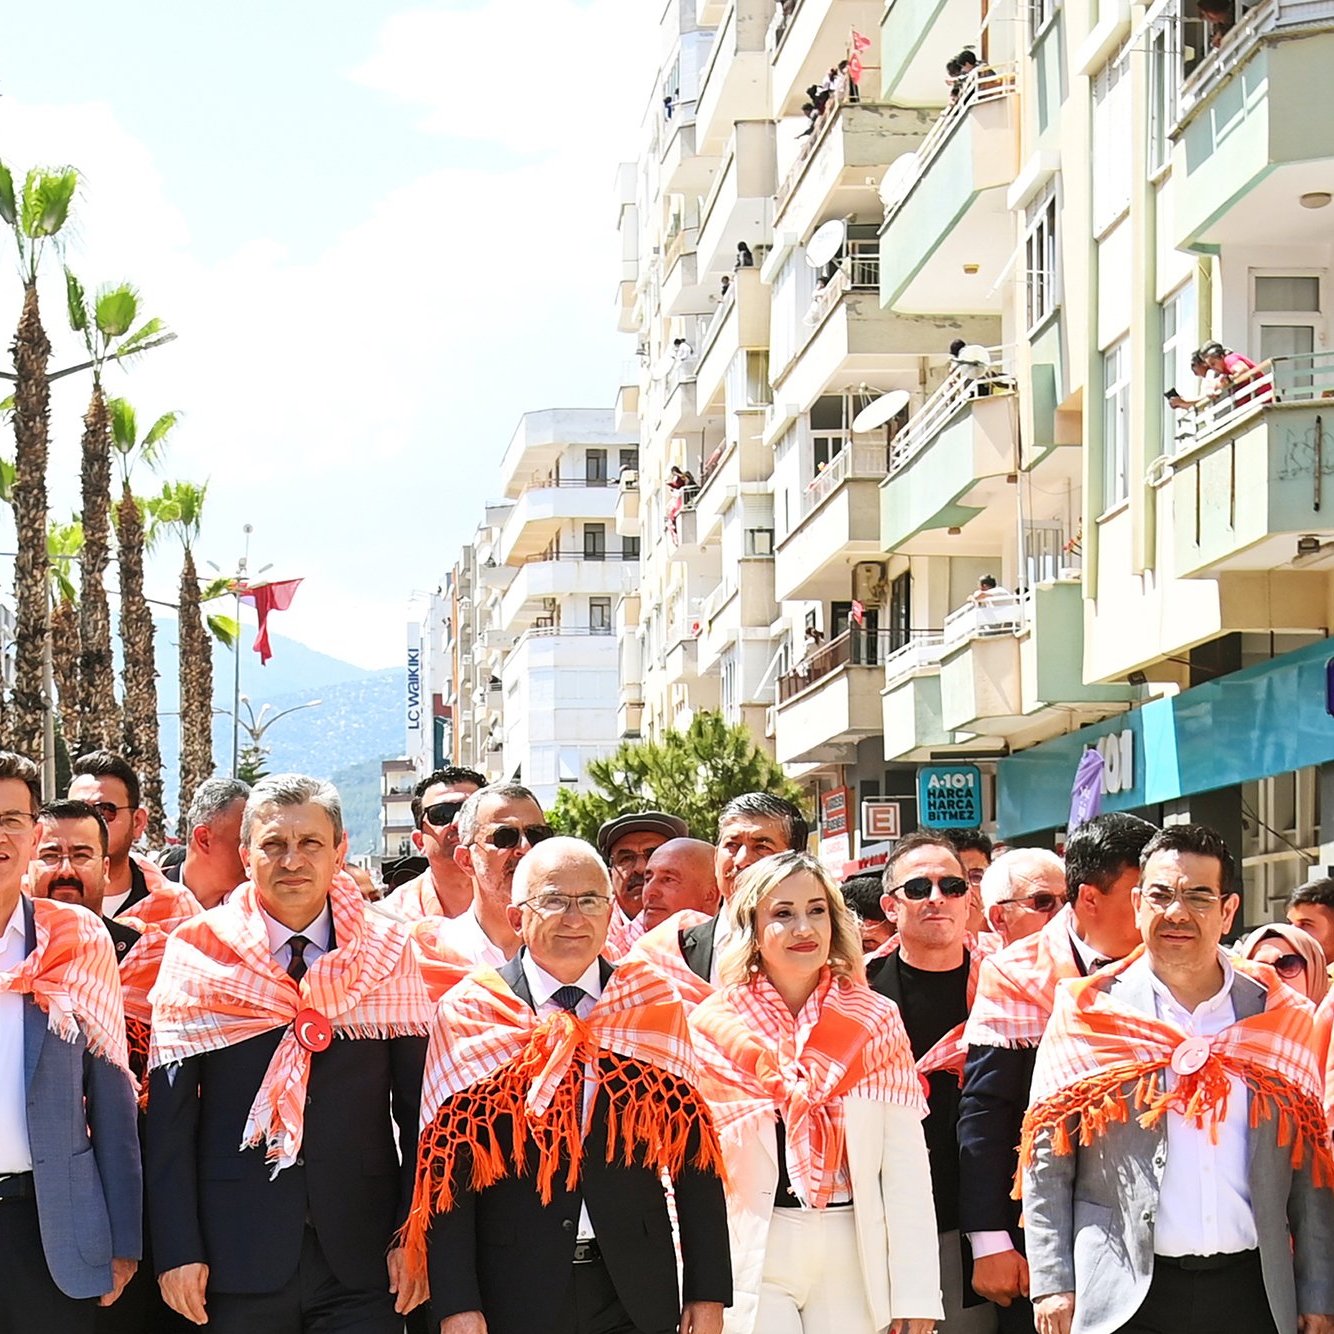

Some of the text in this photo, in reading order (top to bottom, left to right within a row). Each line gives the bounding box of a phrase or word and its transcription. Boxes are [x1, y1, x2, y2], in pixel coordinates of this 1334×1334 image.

[407, 709, 421, 730] LC
[927, 788, 974, 799] HARCA
[927, 799, 974, 811] HARCA
